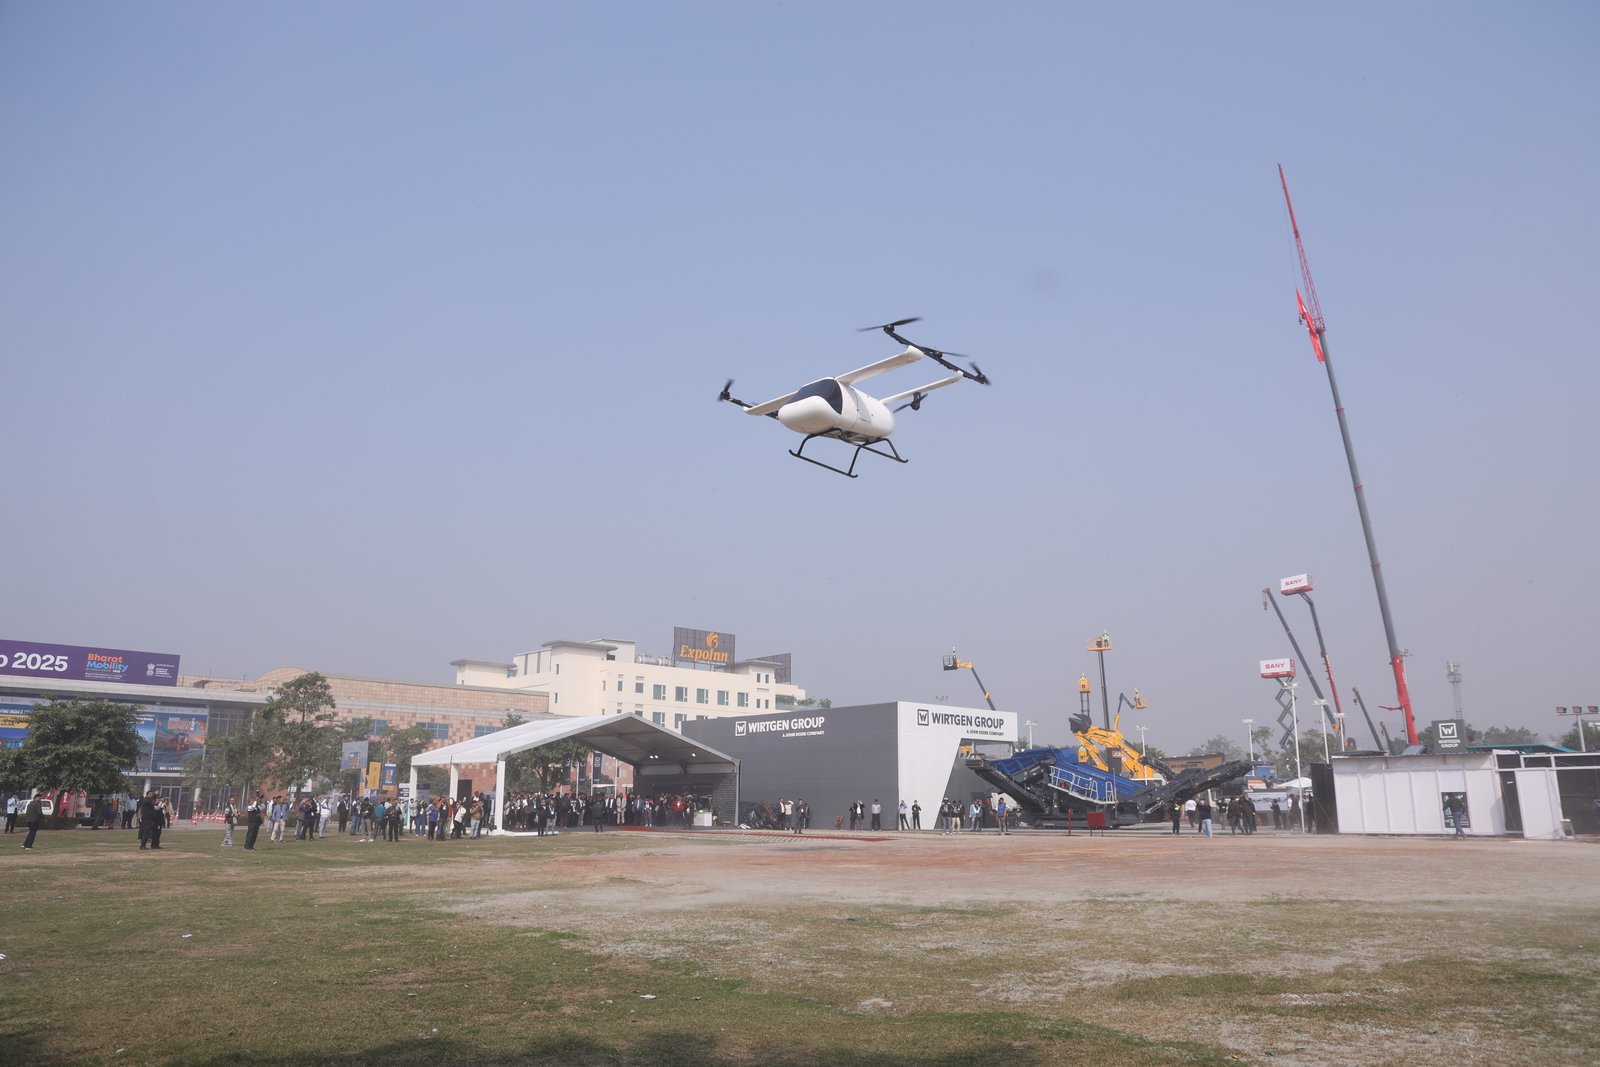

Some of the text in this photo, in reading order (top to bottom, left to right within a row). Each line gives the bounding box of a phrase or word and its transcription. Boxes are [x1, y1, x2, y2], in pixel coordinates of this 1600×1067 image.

[1284, 578, 1303, 587] SANY
[12, 652, 69, 672] 2025
[88, 653, 123, 663] Bharat
[86, 660, 128, 672] Mobility
[748, 720, 789, 733] WIRTGEN
[791, 717, 825, 730] GROUP
[931, 712, 973, 727] WIRTGEN
[974, 716, 1004, 729] GROUP
